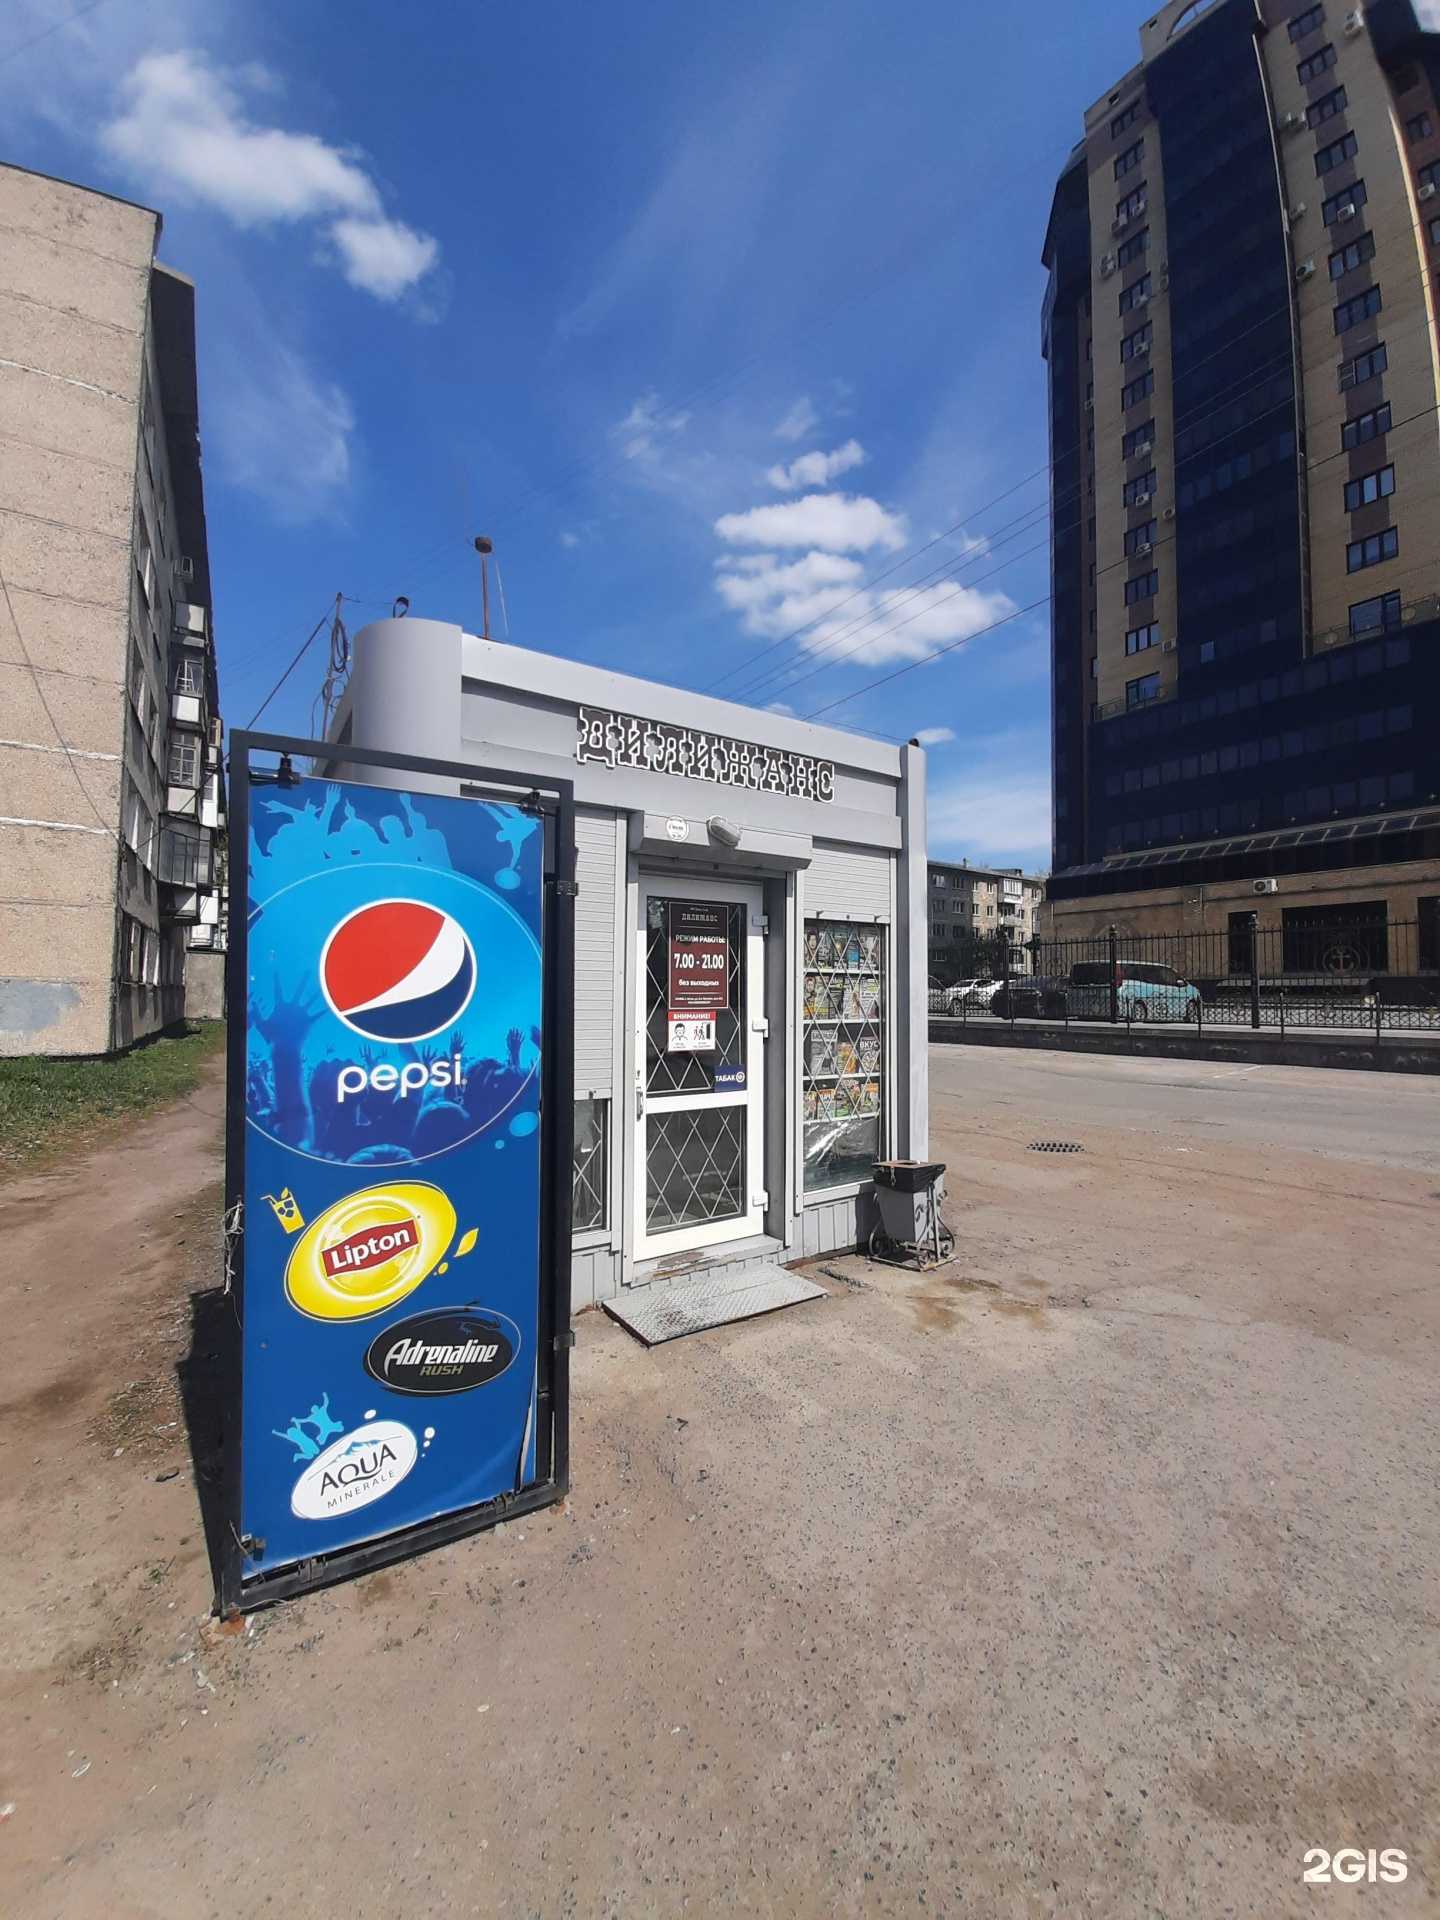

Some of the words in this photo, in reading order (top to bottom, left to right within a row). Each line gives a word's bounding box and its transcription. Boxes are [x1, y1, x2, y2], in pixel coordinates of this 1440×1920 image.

[577, 706, 835, 803] ДИЛИЖАНС
[675, 934, 699, 943] РЕЖИМ
[673, 953, 694, 969] 7.00
[701, 954, 724, 970] 21.00
[337, 1053, 463, 1103] pepsi
[715, 1074, 735, 1082] ТАБАК
[331, 1228, 411, 1270] Lipton
[384, 1338, 499, 1377] Adrenaline
[420, 1365, 463, 1376] RUSH
[319, 1443, 397, 1496] AQUA
[327, 1470, 396, 1509] MINERALE
